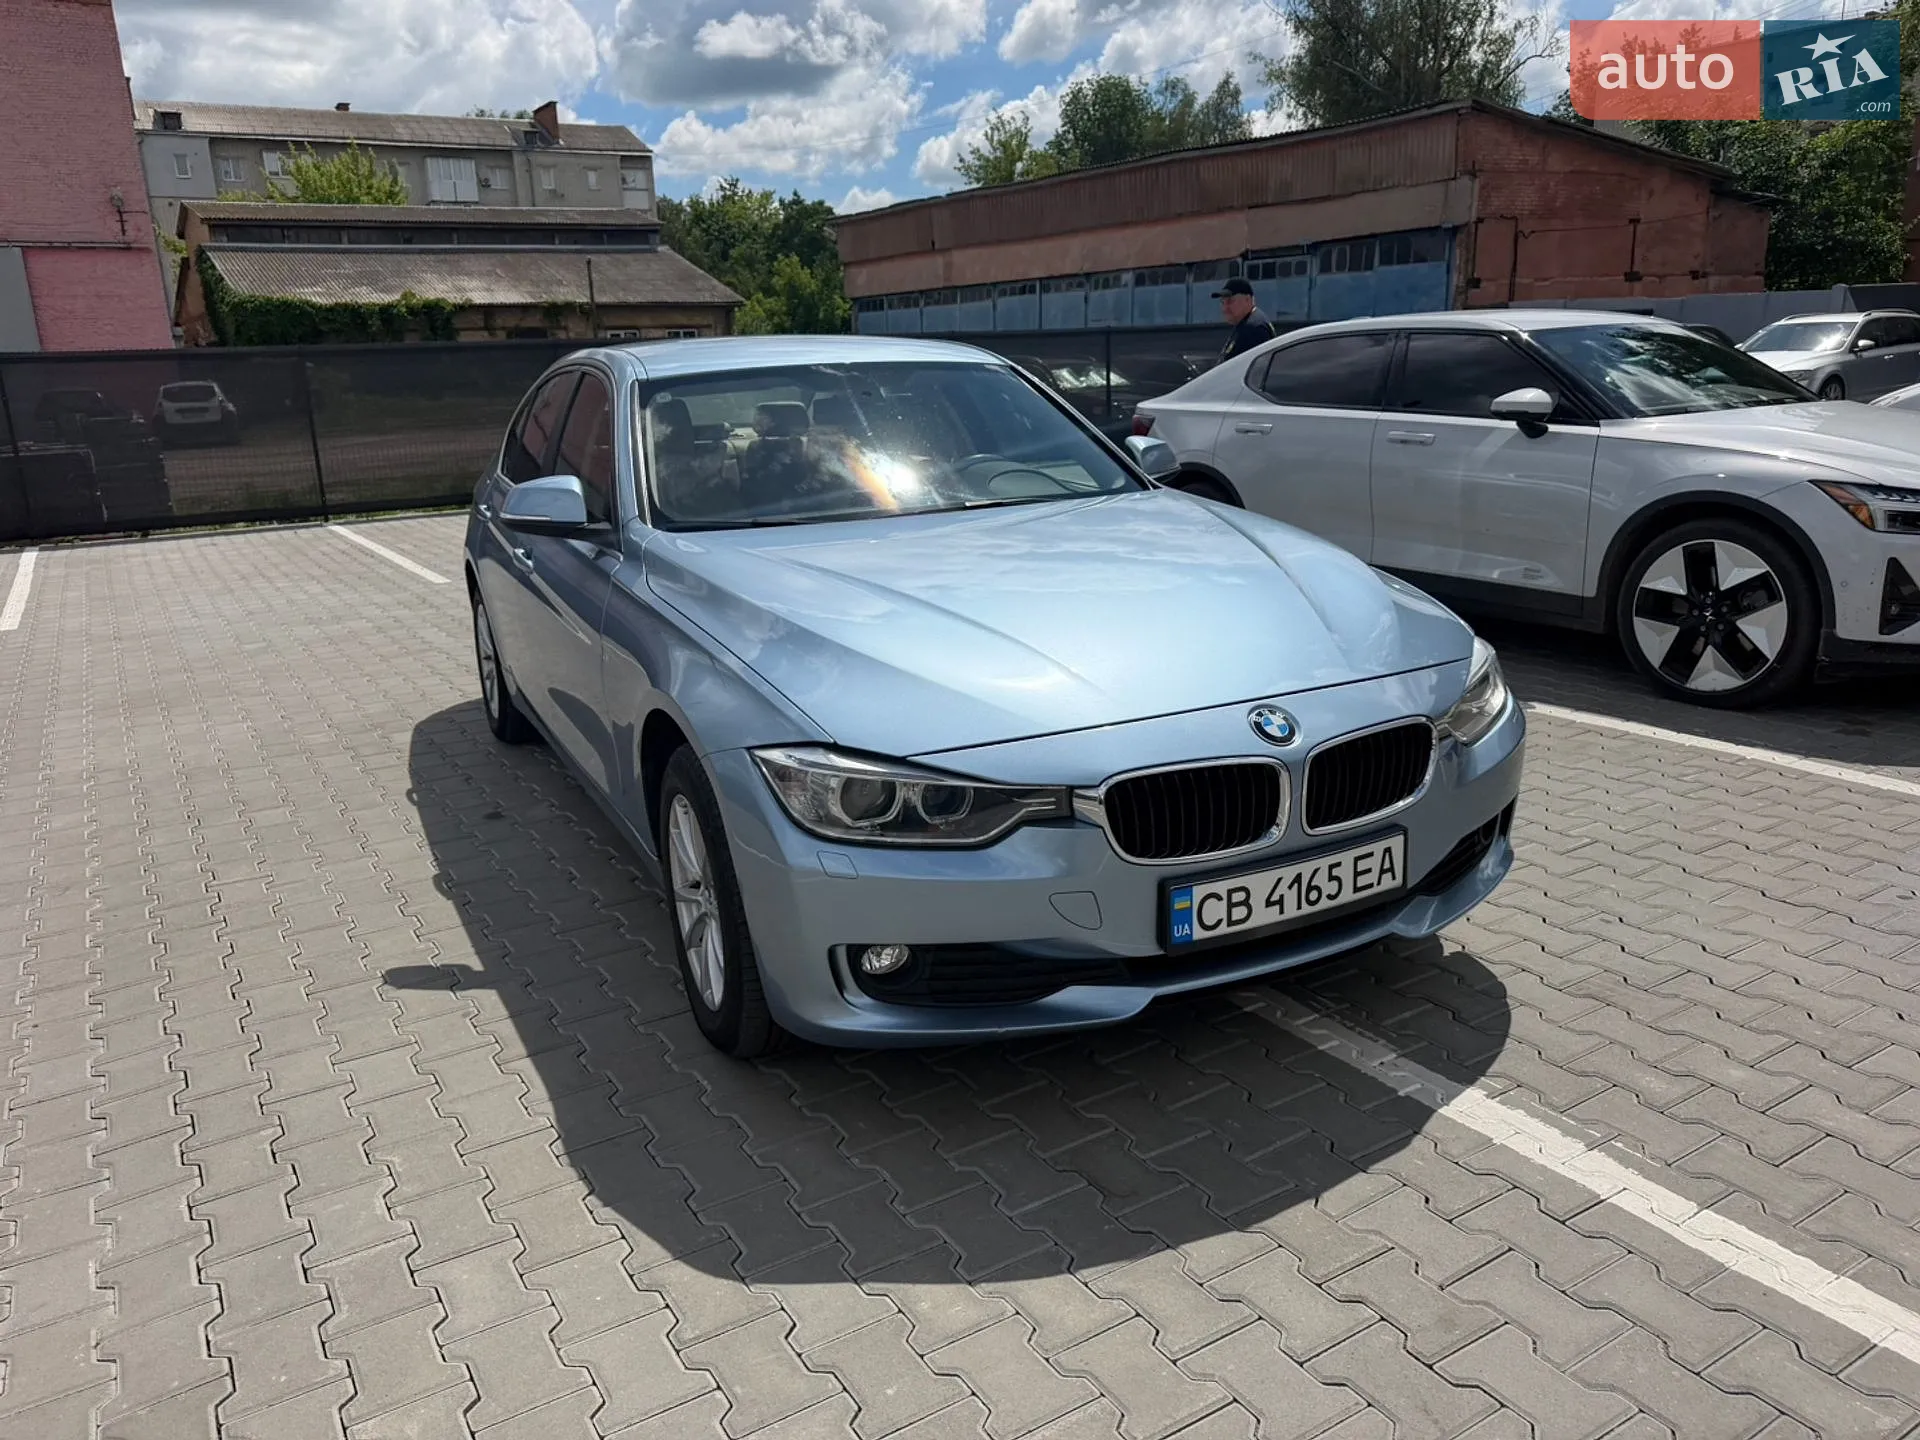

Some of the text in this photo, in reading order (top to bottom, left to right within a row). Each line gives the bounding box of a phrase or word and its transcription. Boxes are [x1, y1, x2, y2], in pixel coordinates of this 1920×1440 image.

[1196, 846, 1397, 931] CB 4165 EA
[1173, 923, 1191, 937] UA
